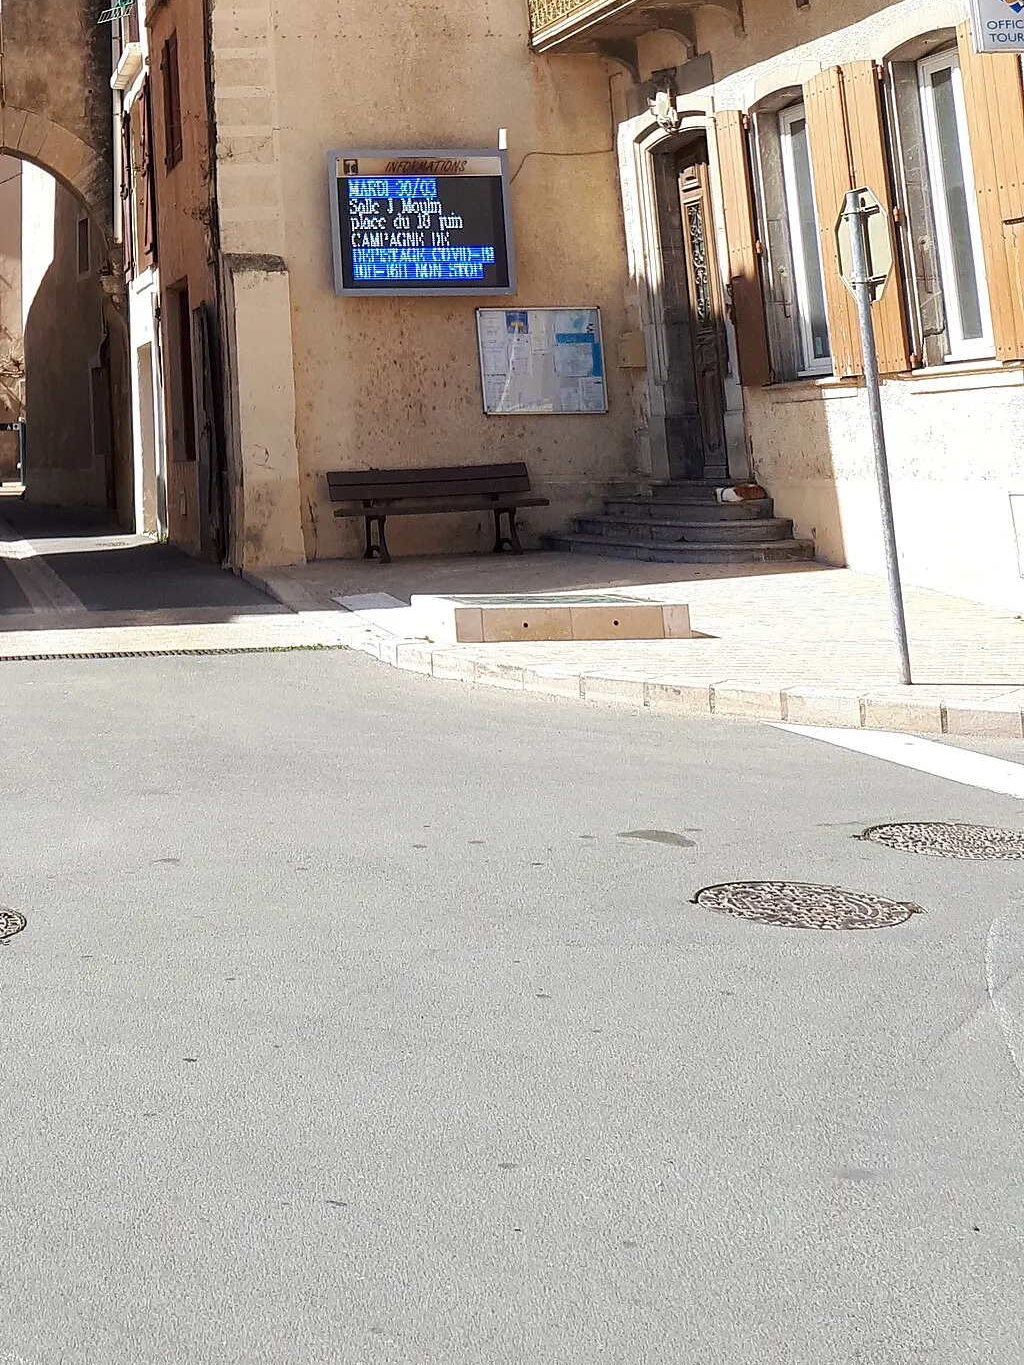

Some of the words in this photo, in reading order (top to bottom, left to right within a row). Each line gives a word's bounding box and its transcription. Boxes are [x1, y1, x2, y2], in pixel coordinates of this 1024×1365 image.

[385, 160, 468, 173] INFORMATIONS
[348, 179, 390, 196] MARDI
[396, 178, 437, 197] 30/03
[349, 198, 380, 214] Salle
[387, 198, 394, 214] J
[402, 198, 442, 215] Moulin
[350, 214, 386, 231] place
[394, 214, 410, 229] du
[438, 213, 464, 230] juin
[351, 232, 425, 247] CAMPAGNE
[432, 232, 450, 247] DE
[448, 263, 484, 278] STOP
